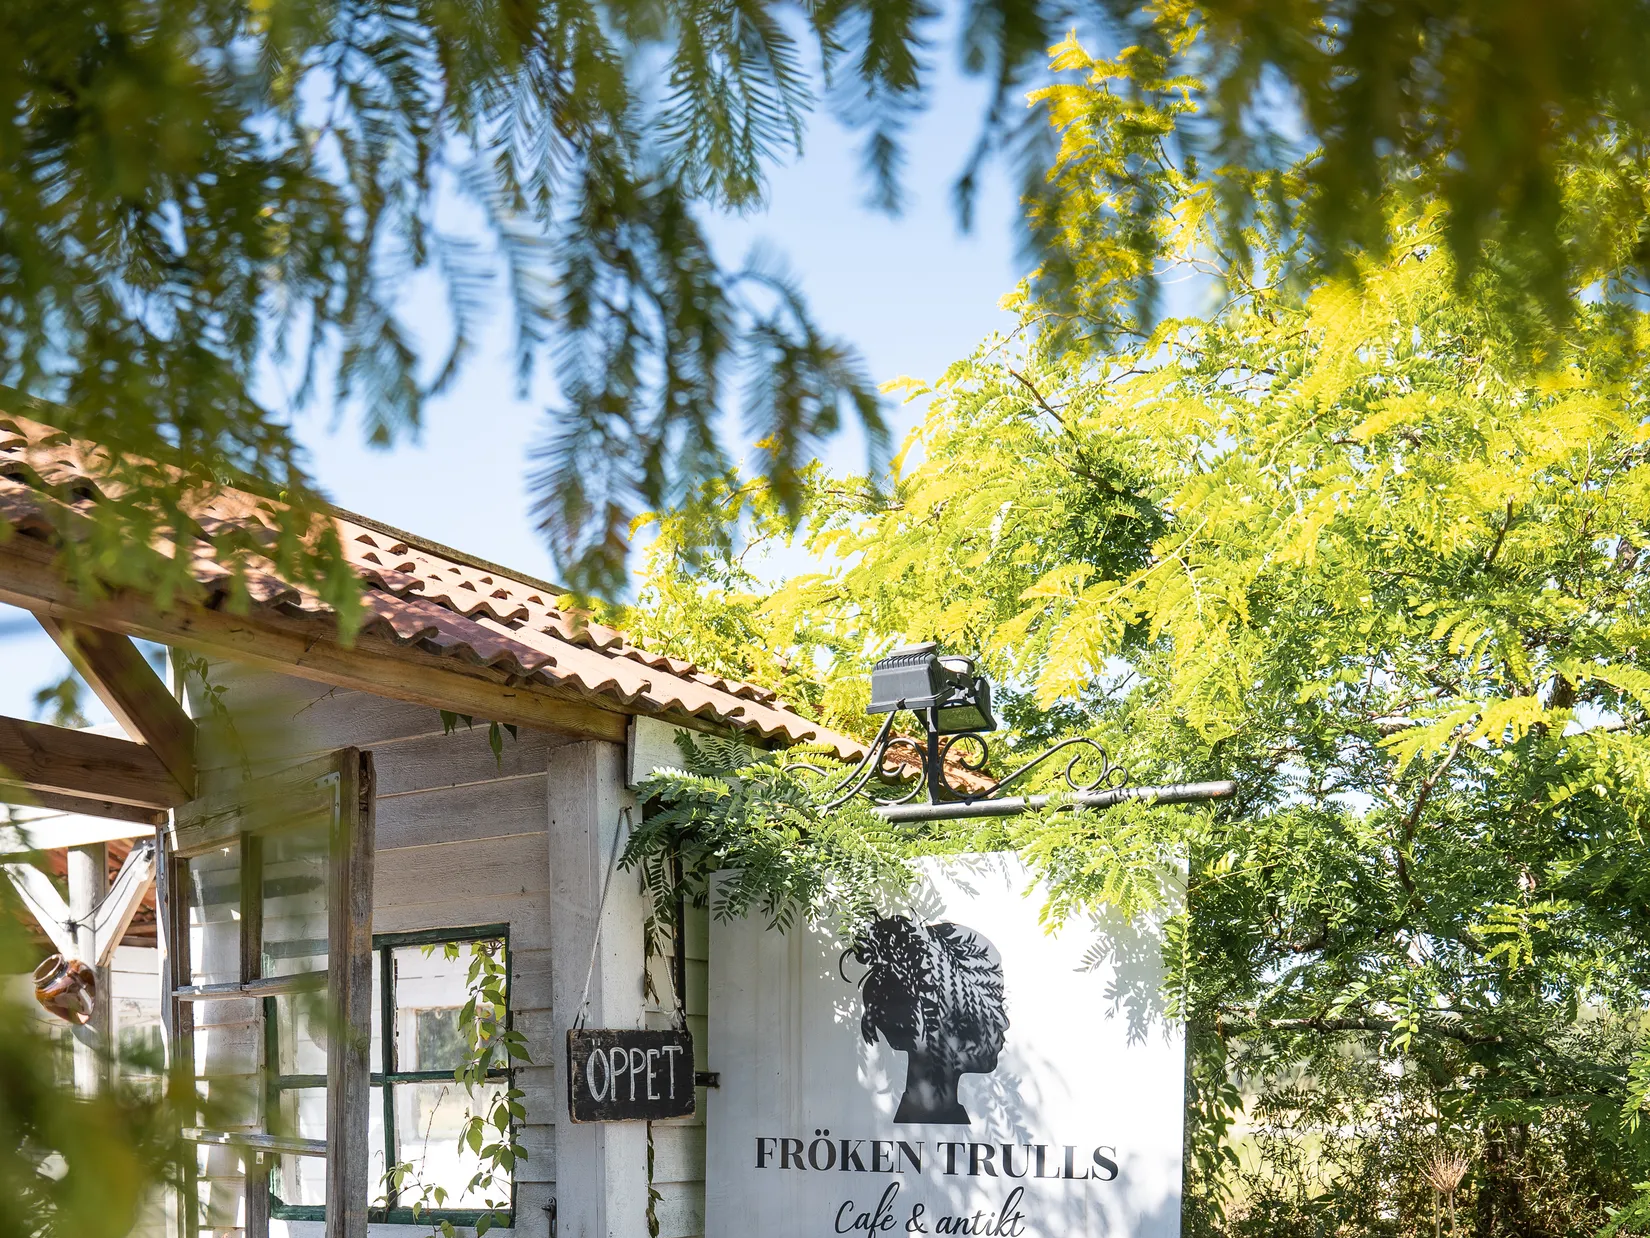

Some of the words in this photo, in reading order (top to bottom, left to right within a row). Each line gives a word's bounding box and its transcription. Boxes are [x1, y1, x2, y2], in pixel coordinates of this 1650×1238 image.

[586, 1038, 684, 1102] ÖPPET
[754, 1128, 926, 1175] FRÖKEN
[937, 1141, 1119, 1182] TRULLS
[905, 1202, 928, 1234] &
[935, 1186, 1026, 1238] antikt
